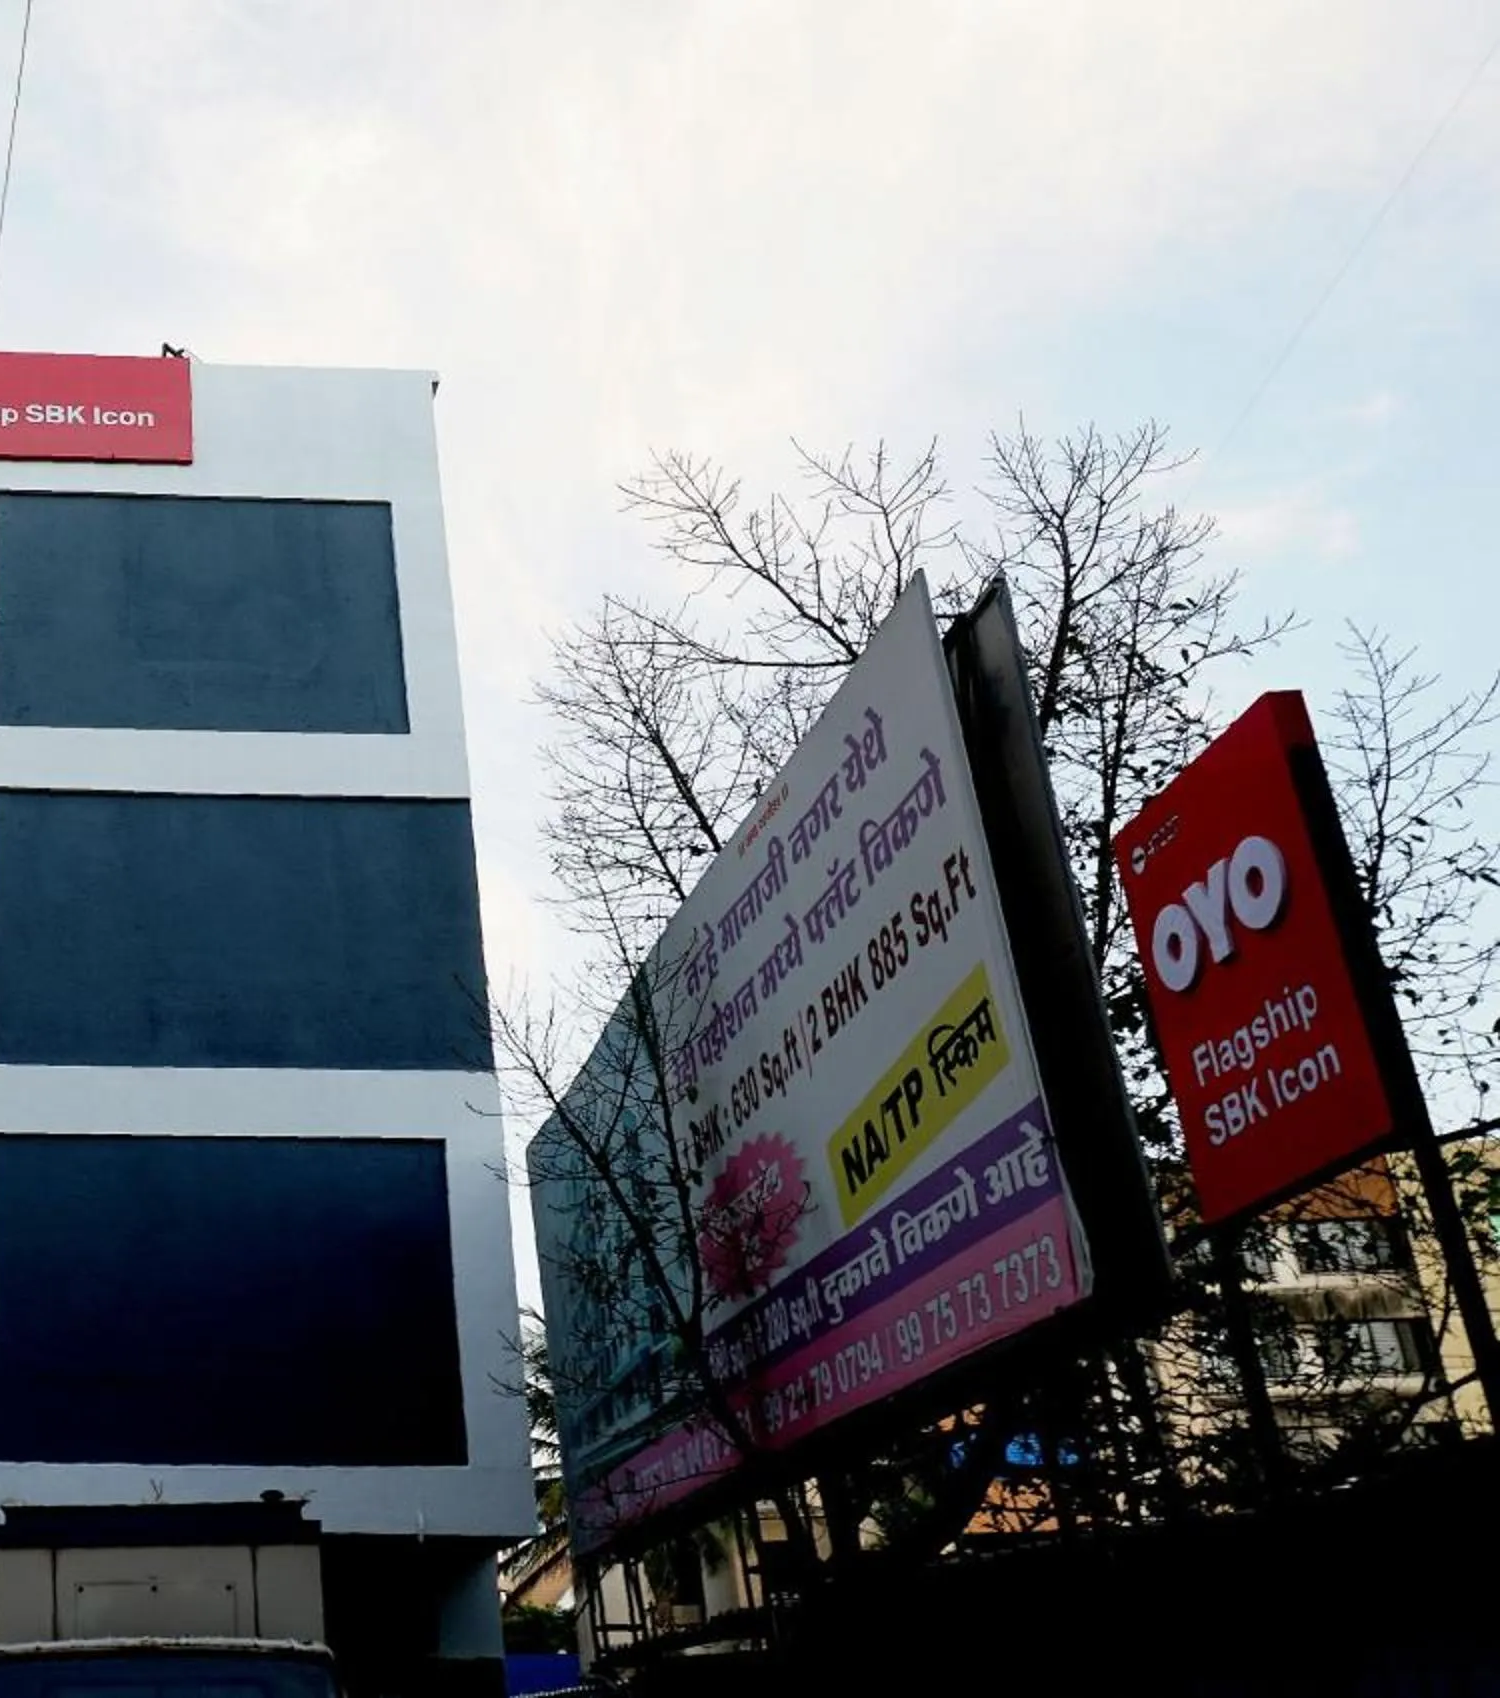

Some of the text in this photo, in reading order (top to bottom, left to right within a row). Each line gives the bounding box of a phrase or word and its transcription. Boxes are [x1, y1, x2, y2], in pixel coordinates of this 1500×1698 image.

[24, 404, 85, 425] SBK
[93, 405, 156, 428] Icon
[787, 773, 843, 864] नगर
[842, 706, 888, 793] येथे
[859, 747, 947, 886] विकणे
[1151, 835, 1287, 993] OYO
[731, 1066, 759, 1128] 630
[760, 1026, 802, 1098] Sq.ft
[806, 1005, 822, 1055] 2
[821, 953, 869, 1038] BHK
[867, 911, 909, 990] 885
[910, 846, 977, 947] Sq.Ft
[1191, 982, 1318, 1088] Flagship
[841, 1067, 923, 1196] NA/TP
[1203, 1042, 1342, 1147] SBK Icon
[890, 1166, 981, 1265] विकणे
[983, 1123, 1050, 1205] आहे
[808, 1359, 834, 1408] 79
[834, 1332, 885, 1394] 0794
[894, 1310, 925, 1364] 99
[924, 1290, 958, 1345] 75
[957, 1271, 992, 1328] 73
[993, 1234, 1062, 1310] 7373
